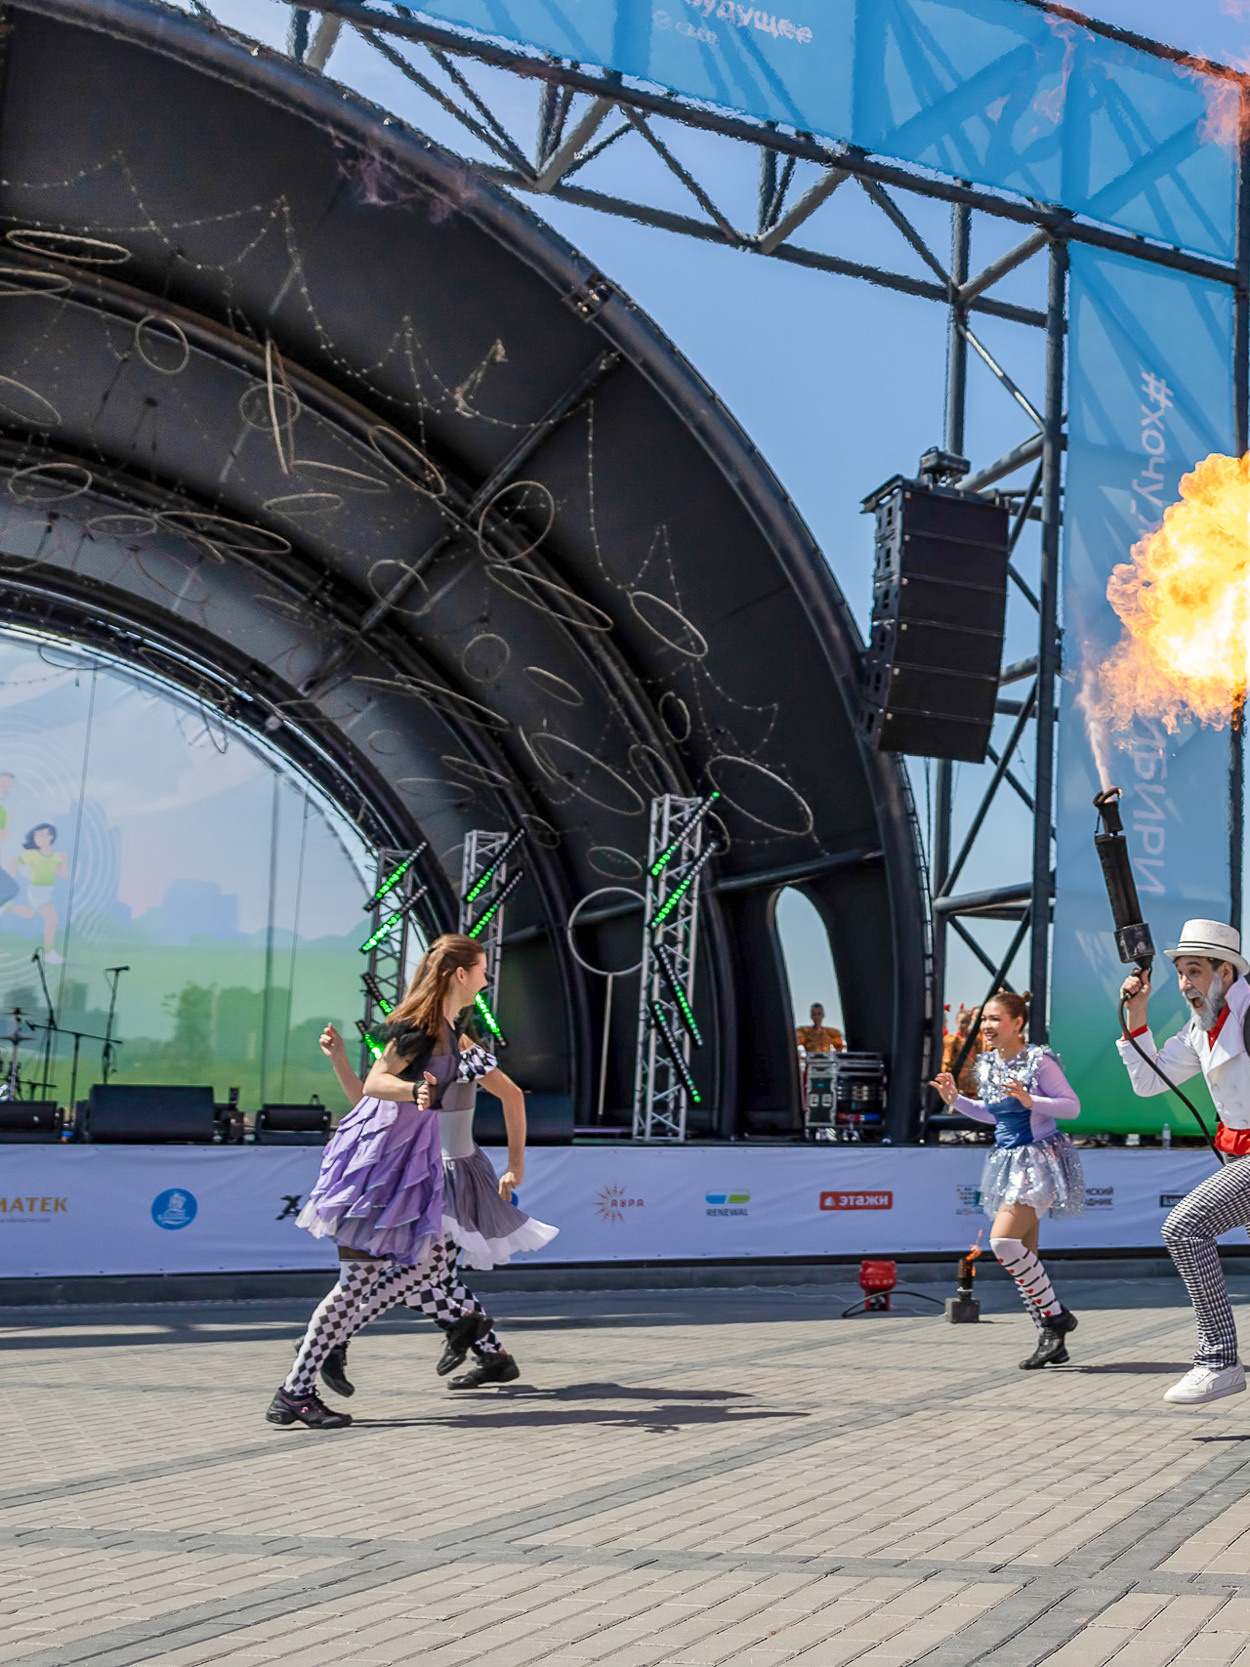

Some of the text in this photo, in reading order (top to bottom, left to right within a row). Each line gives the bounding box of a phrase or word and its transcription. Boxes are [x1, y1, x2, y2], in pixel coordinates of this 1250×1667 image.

[685, 0, 813, 43] удущее
[838, 1195, 889, 1207] этажи
[705, 1208, 749, 1217] RENEWAL
